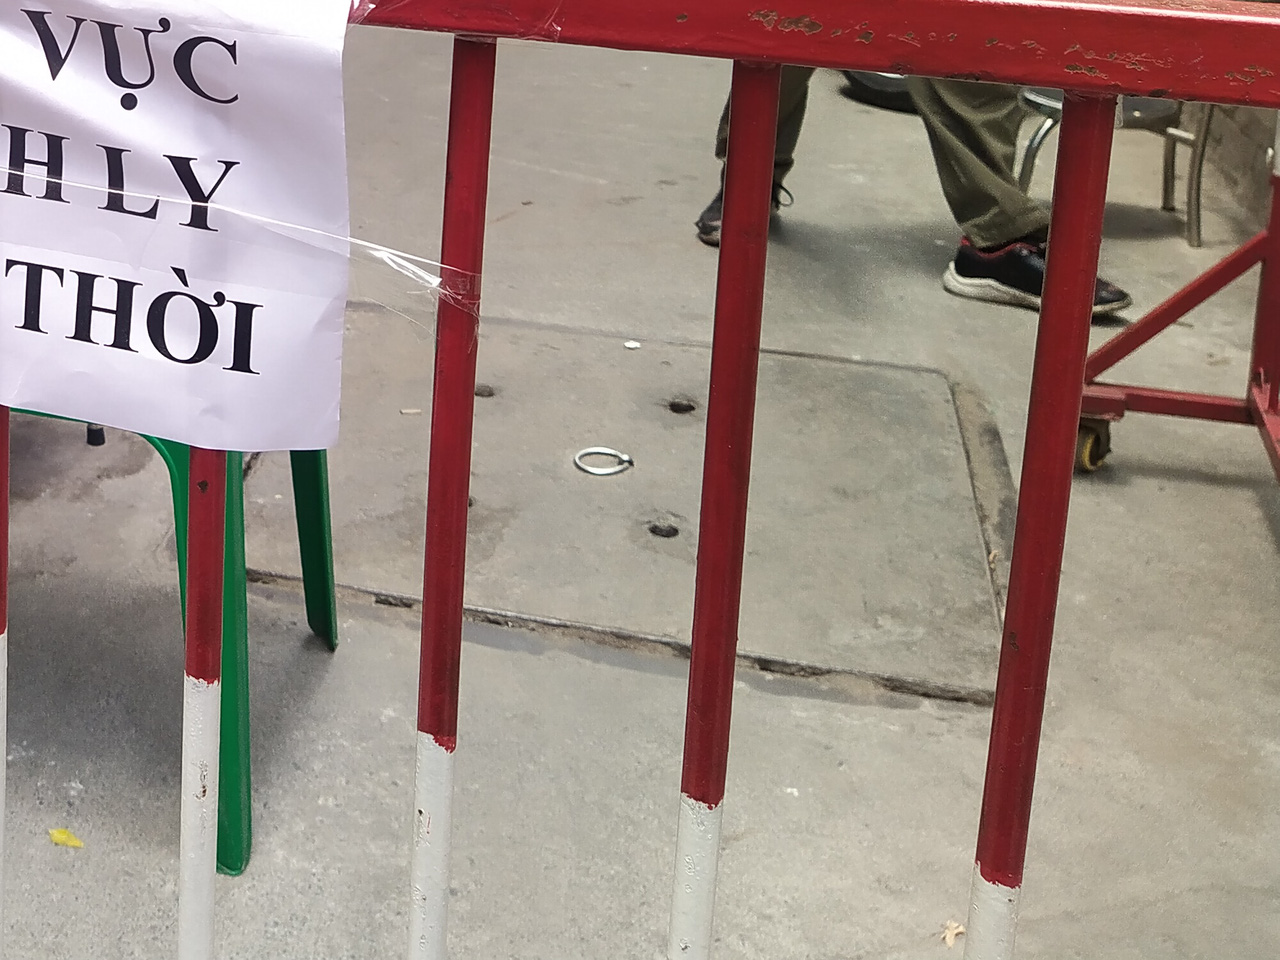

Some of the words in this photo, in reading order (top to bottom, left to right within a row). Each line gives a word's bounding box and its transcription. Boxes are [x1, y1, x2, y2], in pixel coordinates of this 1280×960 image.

[20, 4, 239, 111] VỰC
[96, 143, 240, 232] LY
[5, 258, 264, 375] THỜI
